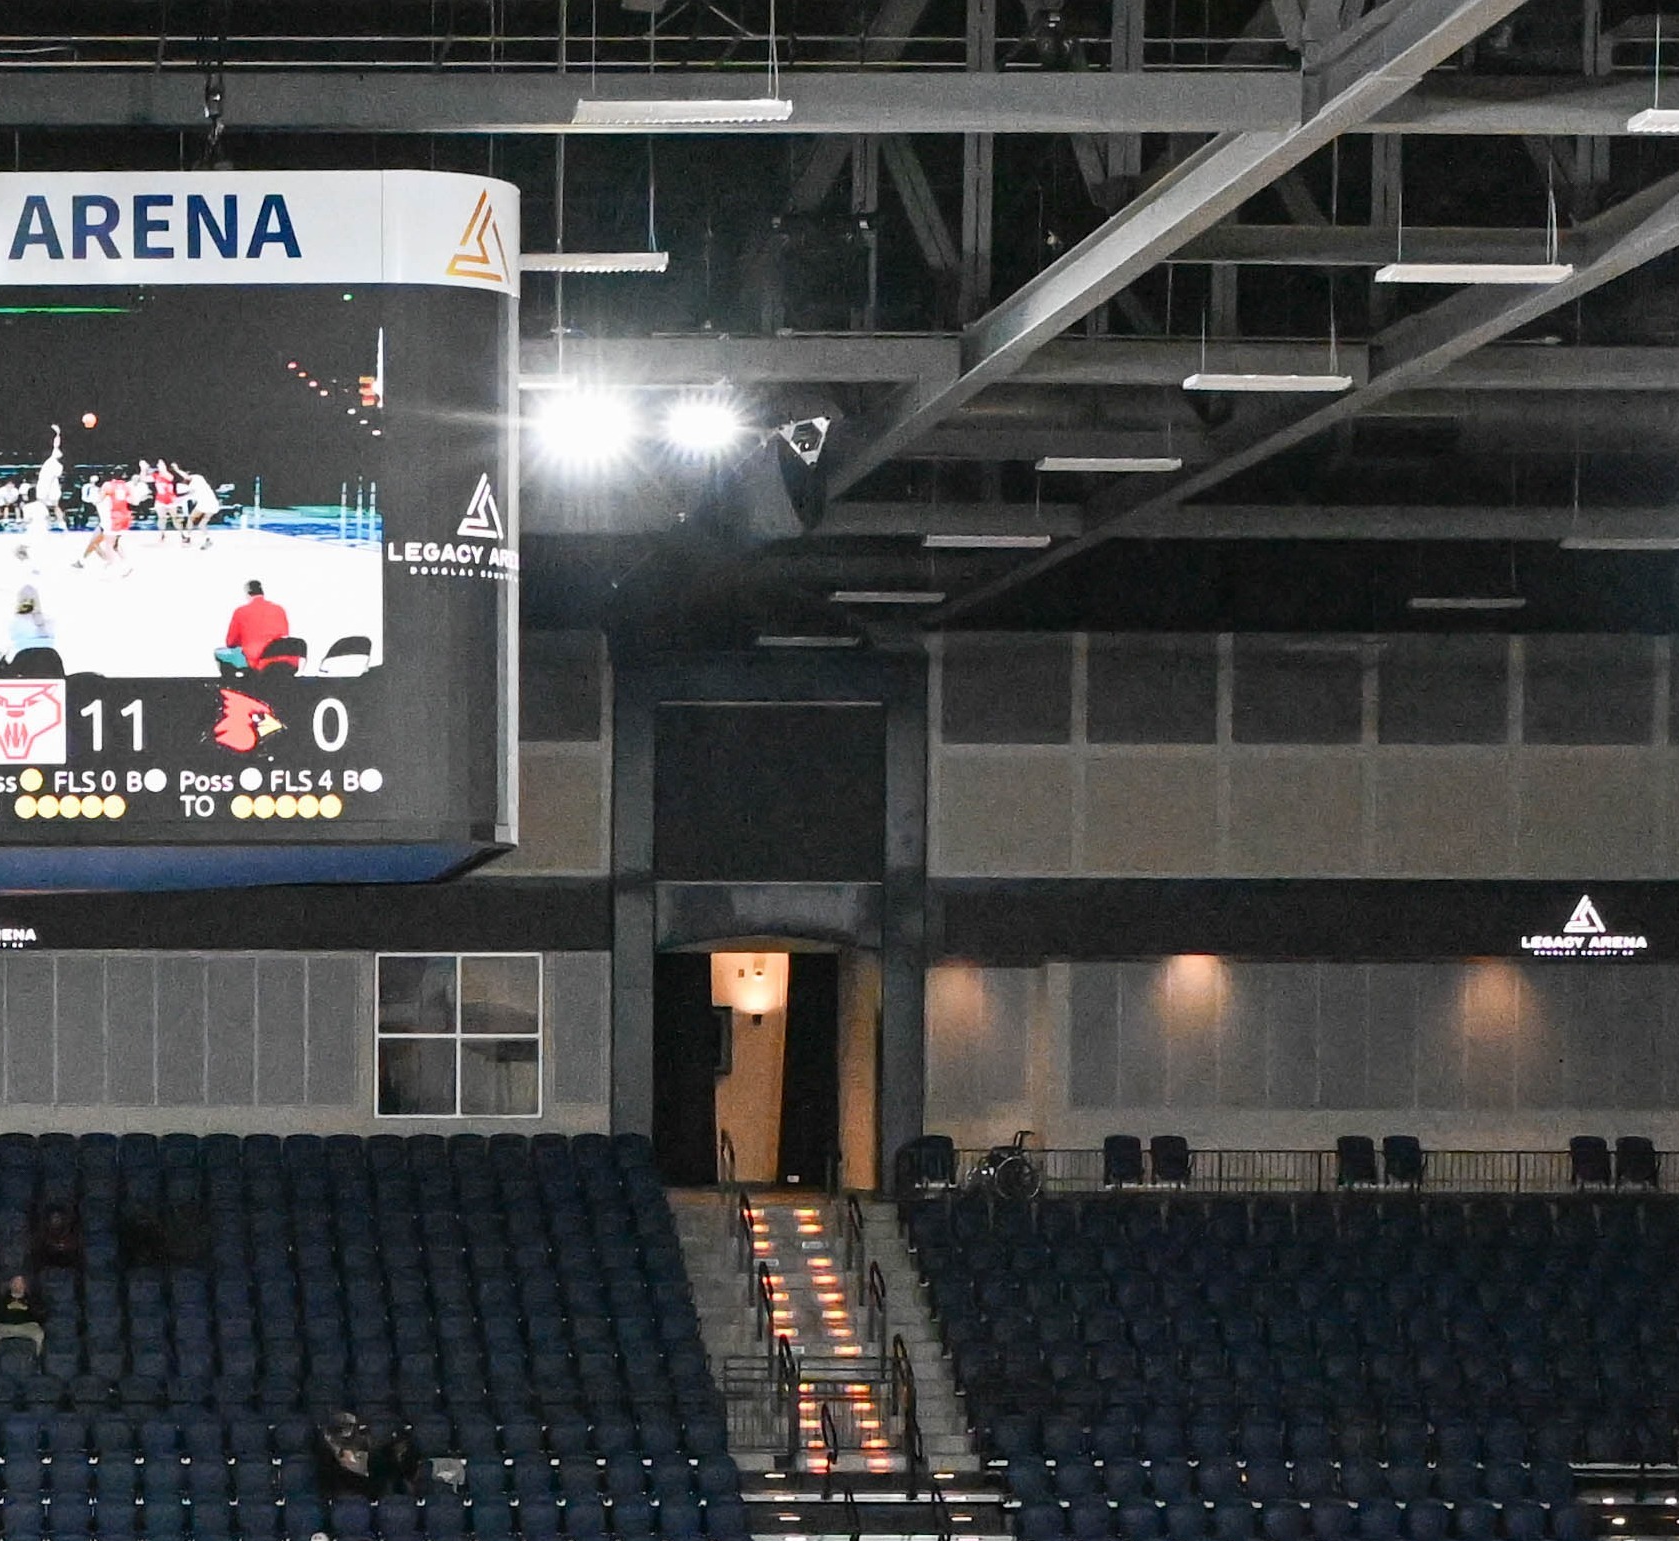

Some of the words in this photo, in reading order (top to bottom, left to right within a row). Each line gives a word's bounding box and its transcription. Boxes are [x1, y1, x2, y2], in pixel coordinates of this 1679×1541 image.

[7, 193, 303, 260] ARENA
[387, 541, 484, 565] LEGACY
[80, 698, 144, 752] 11
[312, 697, 350, 752] 0
[53, 770, 96, 793] FLS
[179, 771, 235, 793] Poss
[269, 770, 313, 792] FLS
[318, 770, 333, 792] 4
[180, 796, 216, 818] TO
[1521, 936, 1585, 949] LEGACY
[1588, 936, 1648, 949] ARENA
